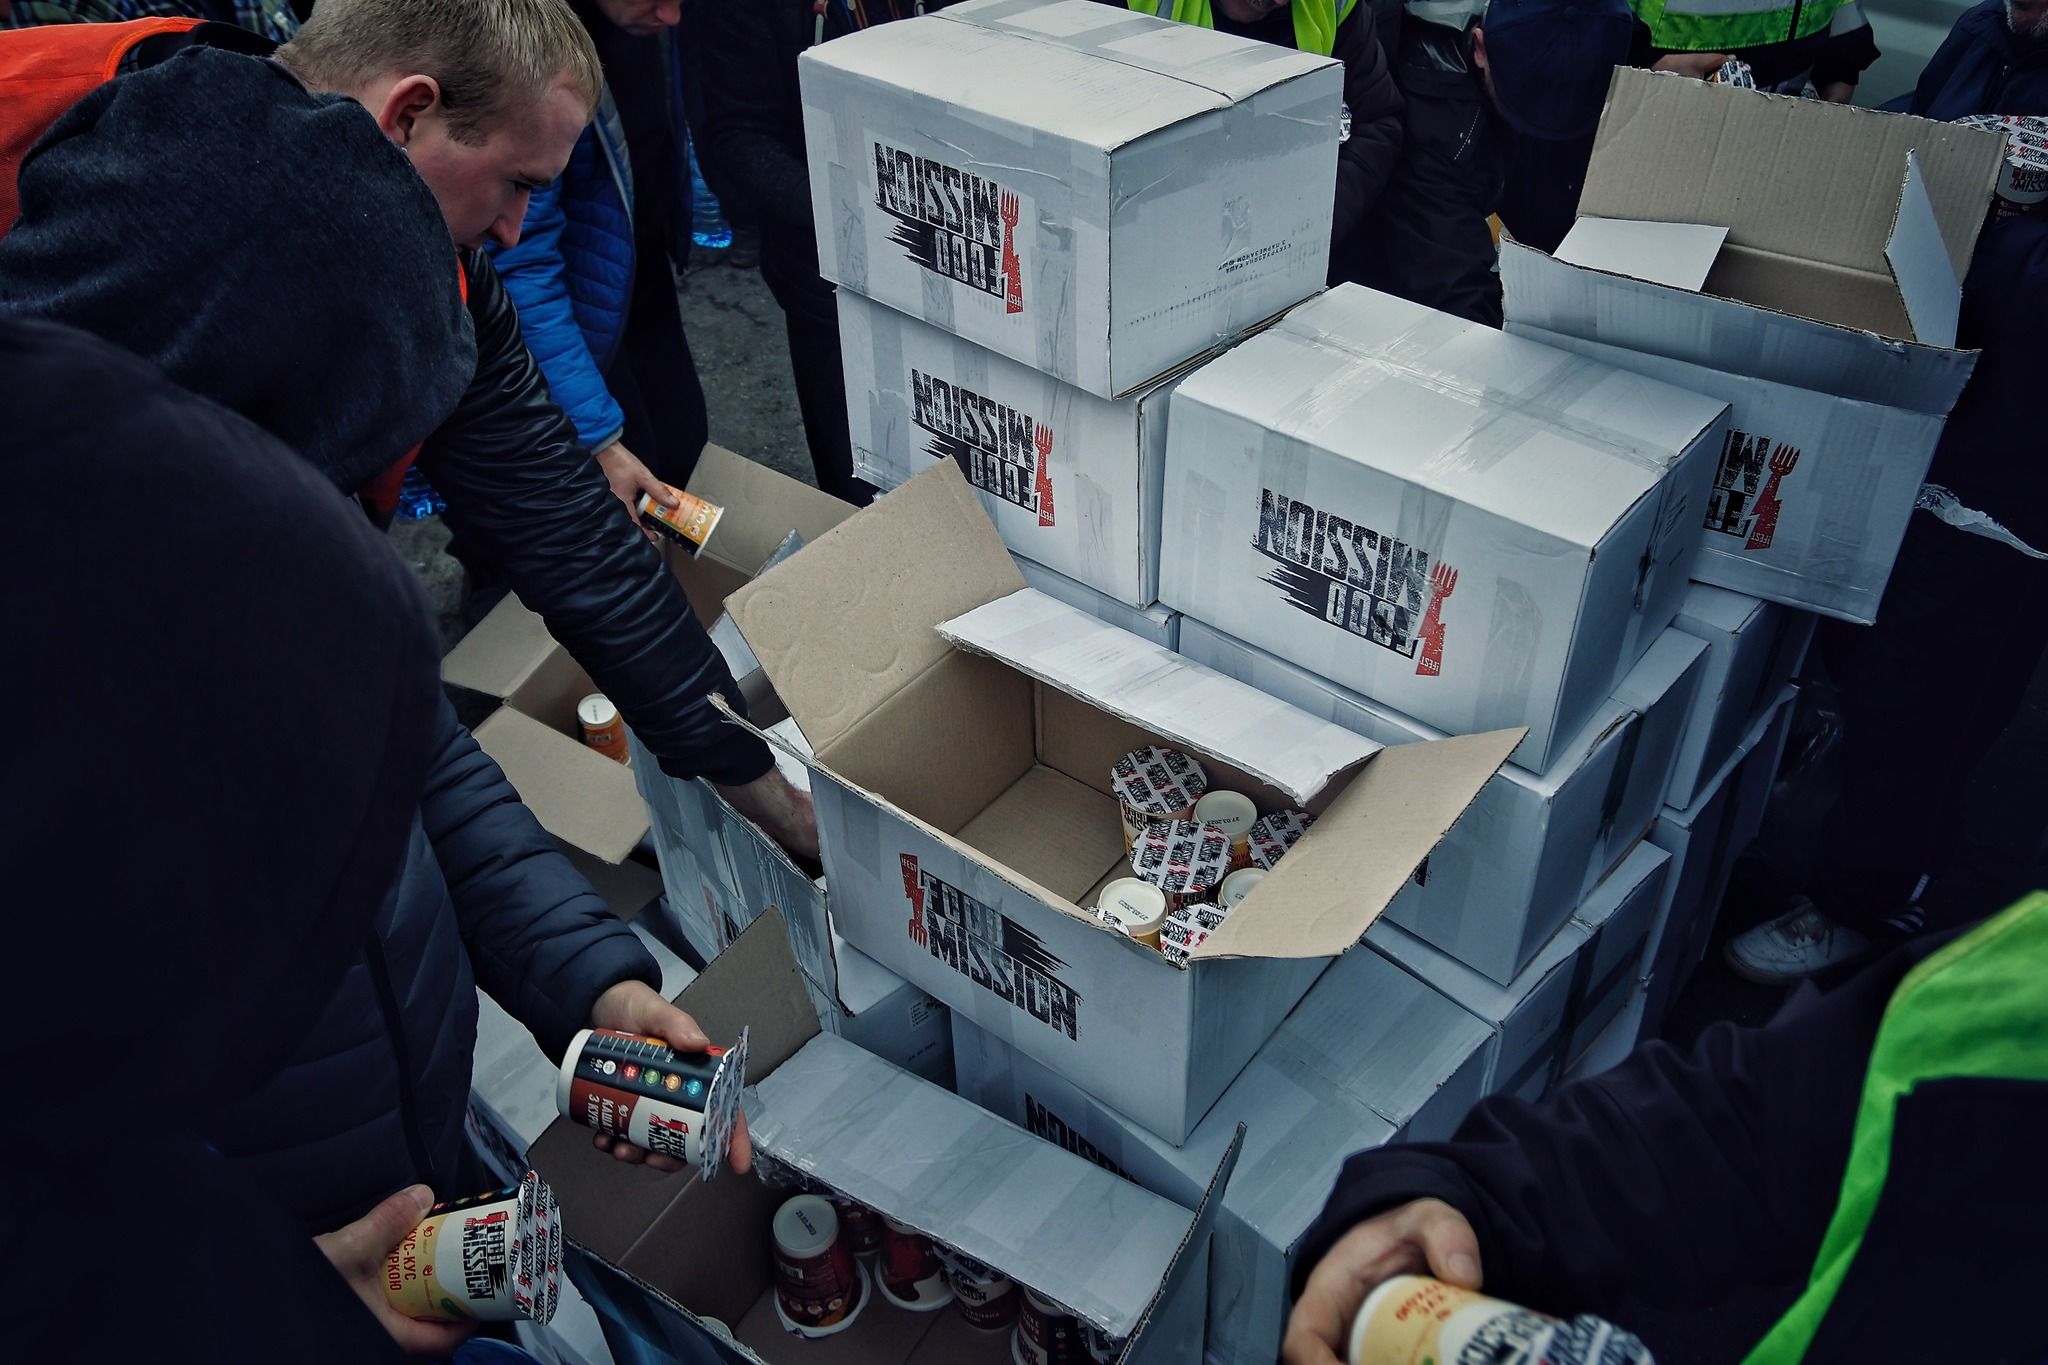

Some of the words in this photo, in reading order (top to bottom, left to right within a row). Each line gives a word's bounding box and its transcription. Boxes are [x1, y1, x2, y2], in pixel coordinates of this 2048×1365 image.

[873, 142, 1001, 248] MISSION
[935, 229, 1003, 296] FOOD
[911, 368, 1034, 470] MISSION
[969, 446, 1036, 511] FOOD
[1258, 487, 1429, 612] MISSION
[1325, 580, 1420, 657] FOOD
[923, 875, 1004, 948] FOOD
[927, 910, 1078, 1042] MISSION
[388, 1244, 402, 1291] УРКОЮ
[463, 1225, 494, 1300] MISSION
